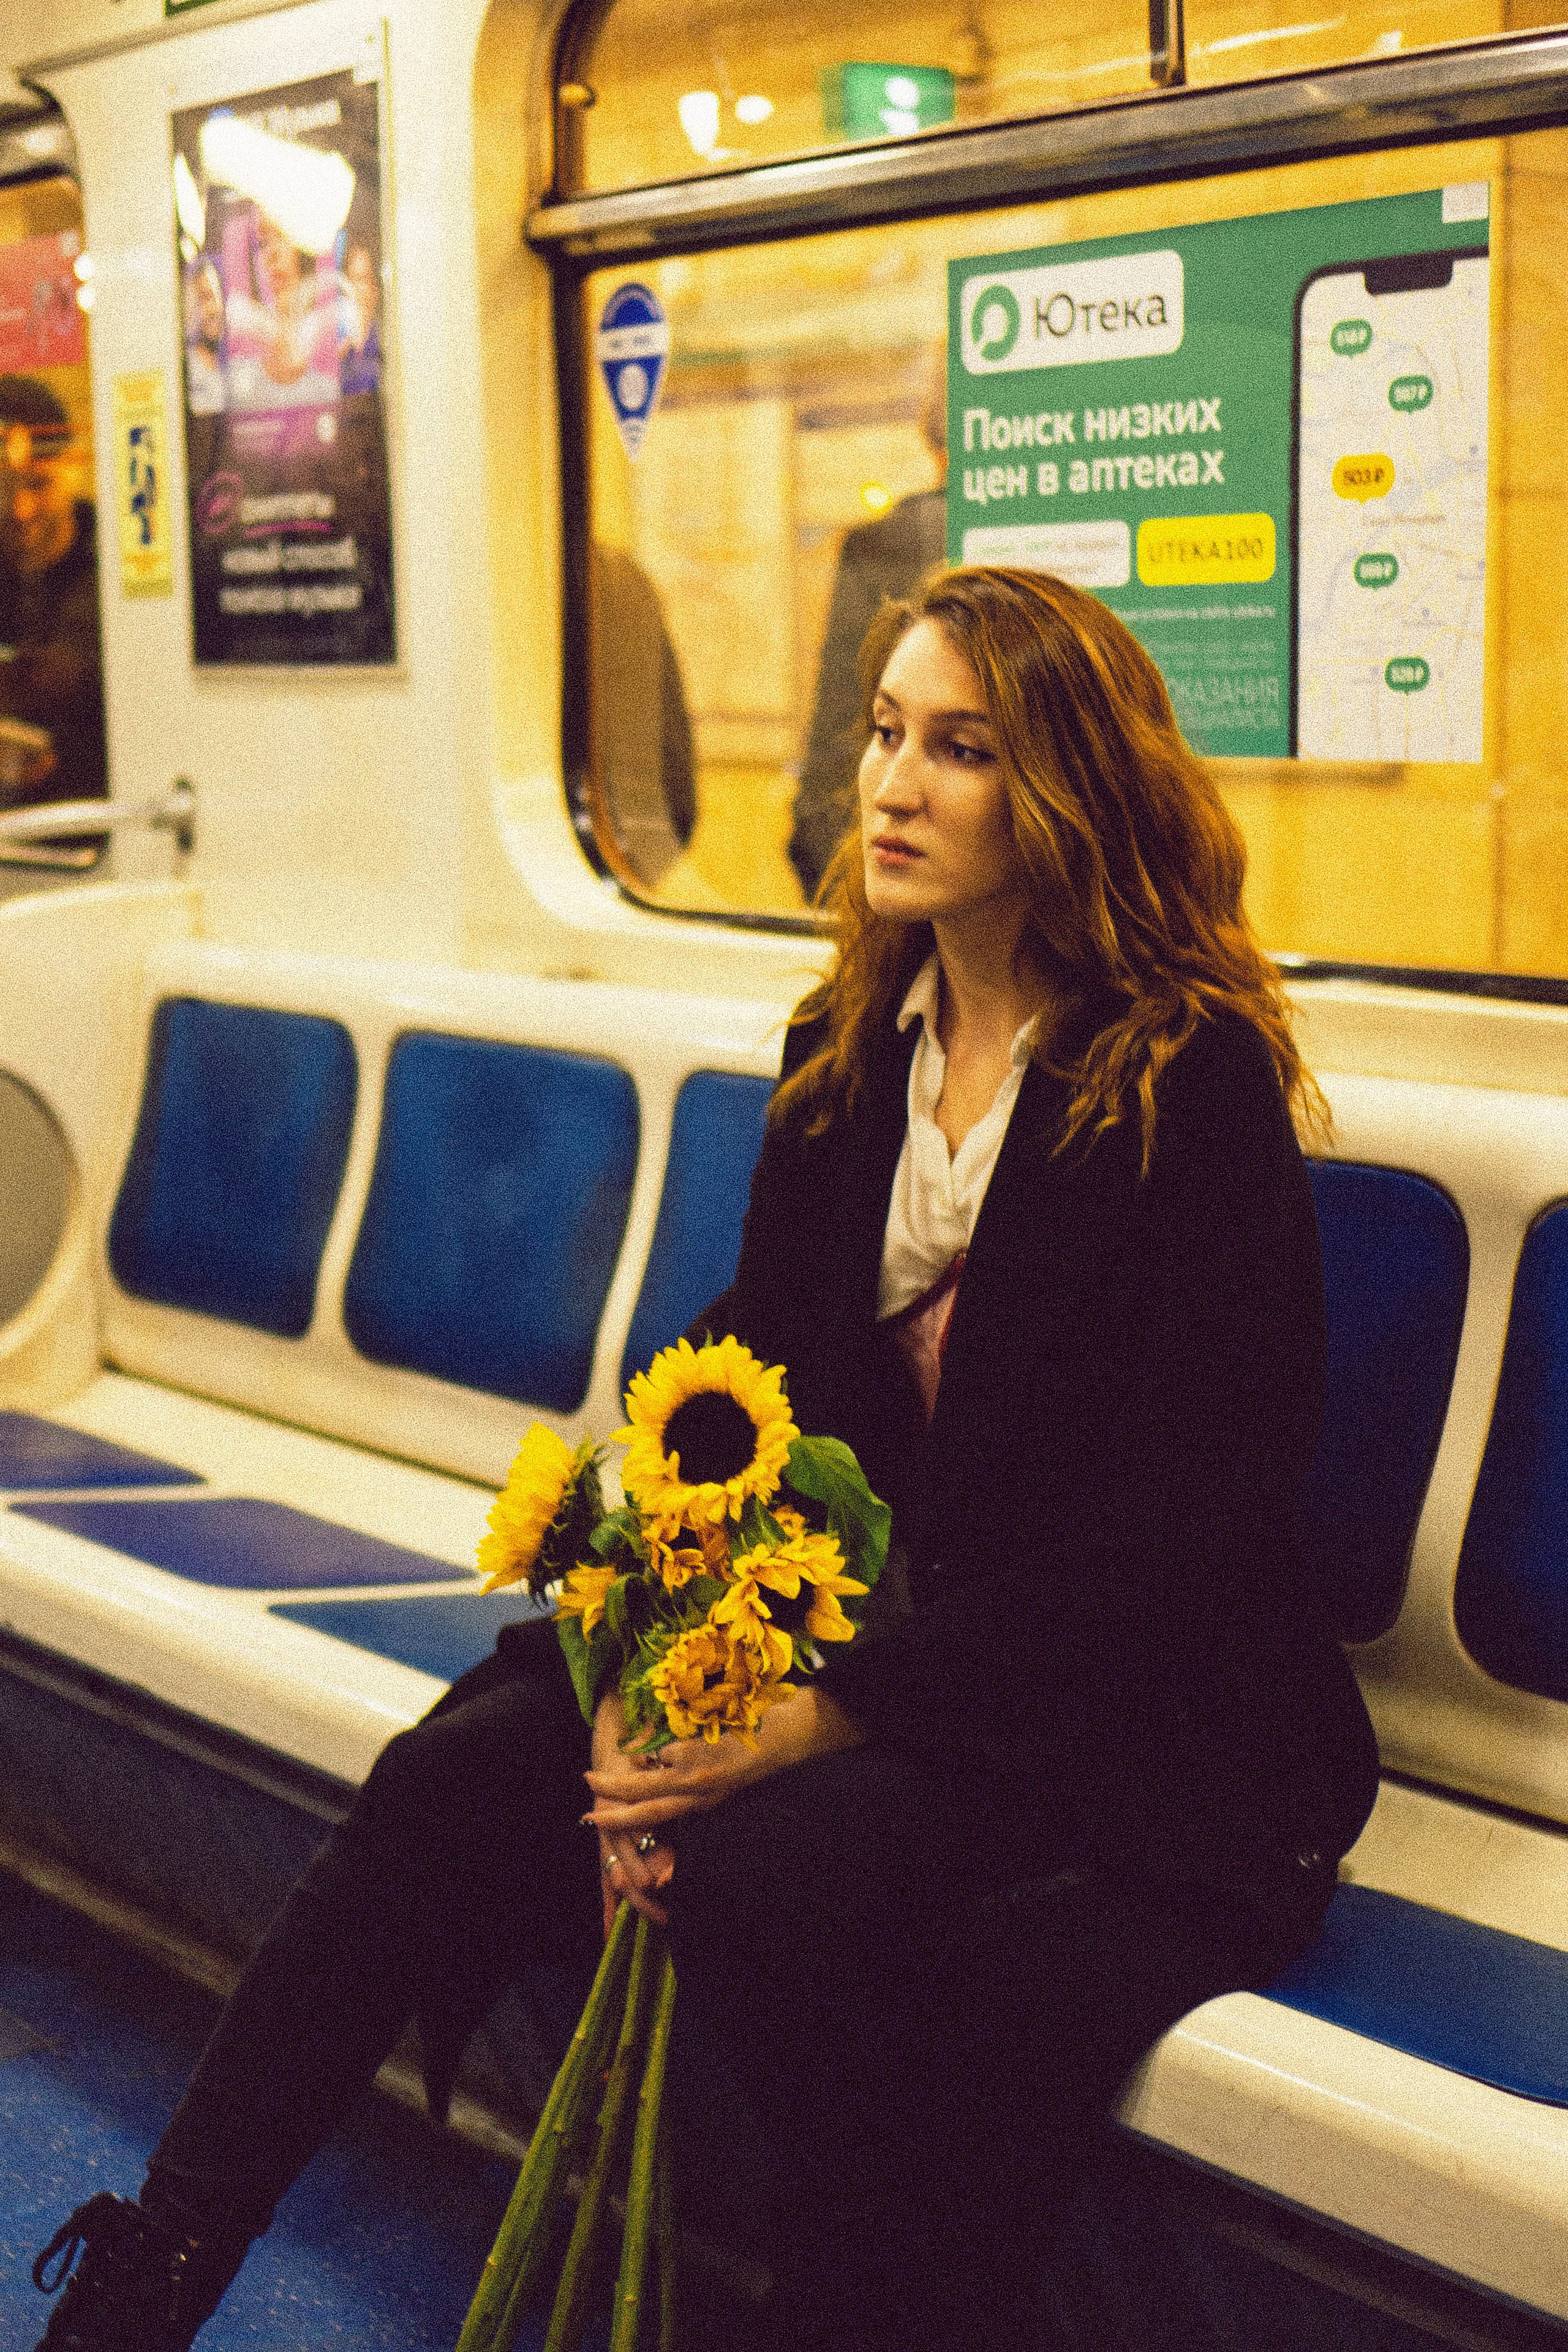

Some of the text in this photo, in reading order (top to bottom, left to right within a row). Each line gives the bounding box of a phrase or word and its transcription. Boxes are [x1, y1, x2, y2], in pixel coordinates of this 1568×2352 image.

[1034, 292, 1169, 340] Ютека
[963, 397, 1222, 452] Поиск низких
[963, 450, 1225, 506] цен в аптеках
[1148, 537, 1264, 564] UTEKA100
